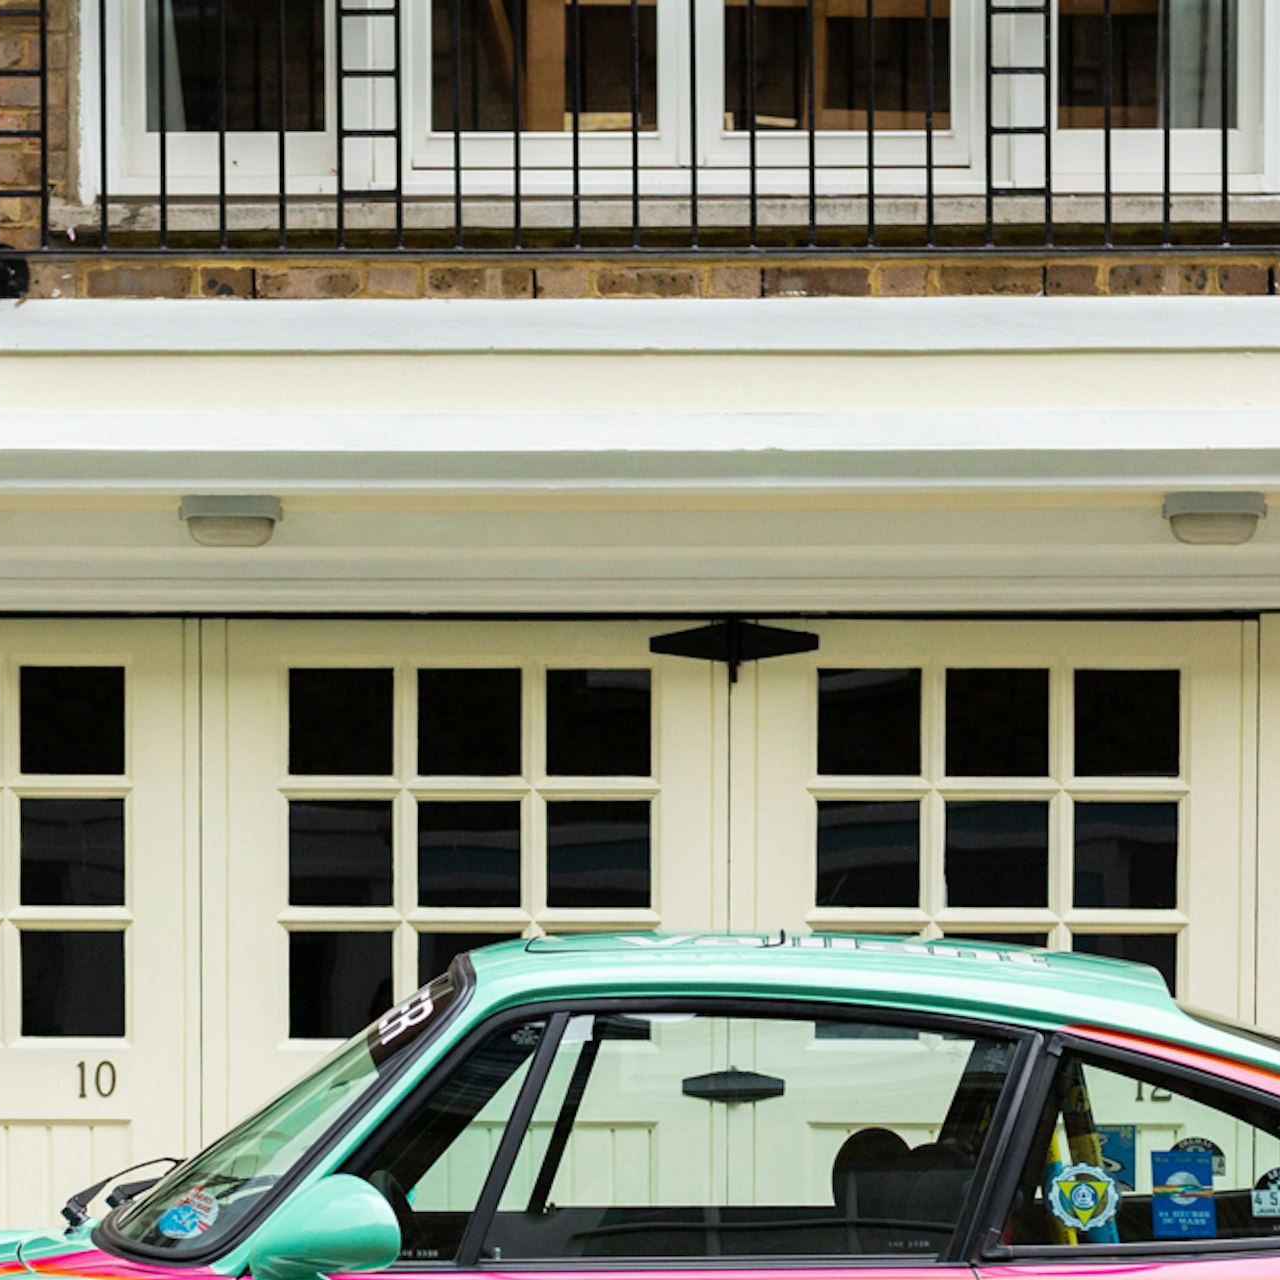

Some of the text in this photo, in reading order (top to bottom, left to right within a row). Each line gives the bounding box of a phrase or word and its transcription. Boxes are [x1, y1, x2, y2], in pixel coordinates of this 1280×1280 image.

[77, 1060, 116, 1098] 10
[1254, 1193, 1262, 1206] 4
[1270, 1192, 1278, 1206] 5
